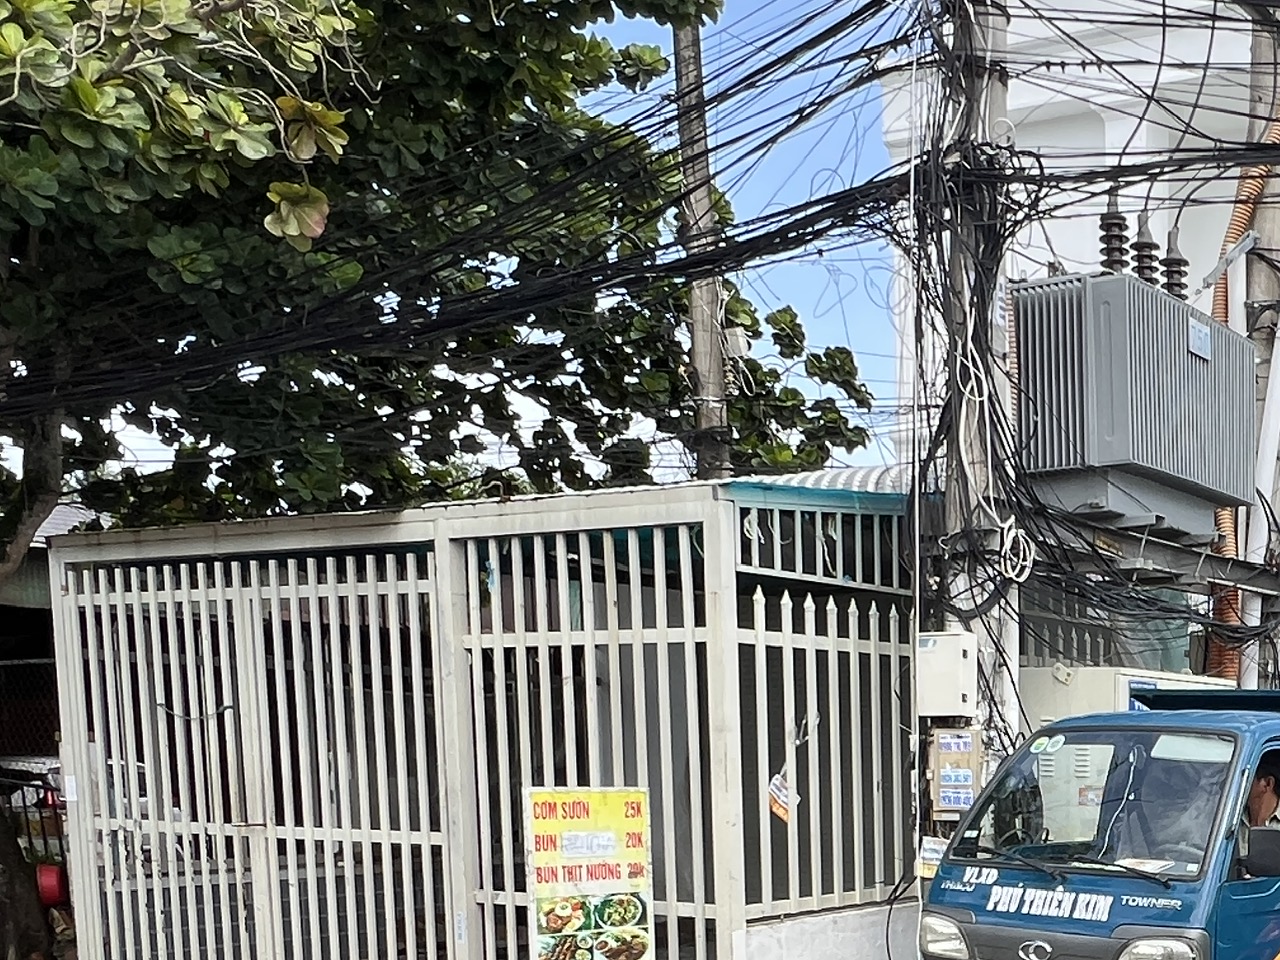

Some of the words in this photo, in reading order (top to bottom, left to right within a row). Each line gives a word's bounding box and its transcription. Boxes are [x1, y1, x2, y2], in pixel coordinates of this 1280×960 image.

[533, 800, 558, 820] CƠM
[624, 801, 643, 818] 25K
[534, 830, 558, 852] BÚN
[625, 831, 644, 849] 20K
[536, 861, 559, 884] BÚN
[586, 860, 621, 881] NƯỚNG
[986, 882, 1024, 913] PHÚ
[1021, 884, 1076, 918] THIÊN
[1072, 892, 1114, 922] KIM
[1120, 895, 1182, 911] TOWNER
